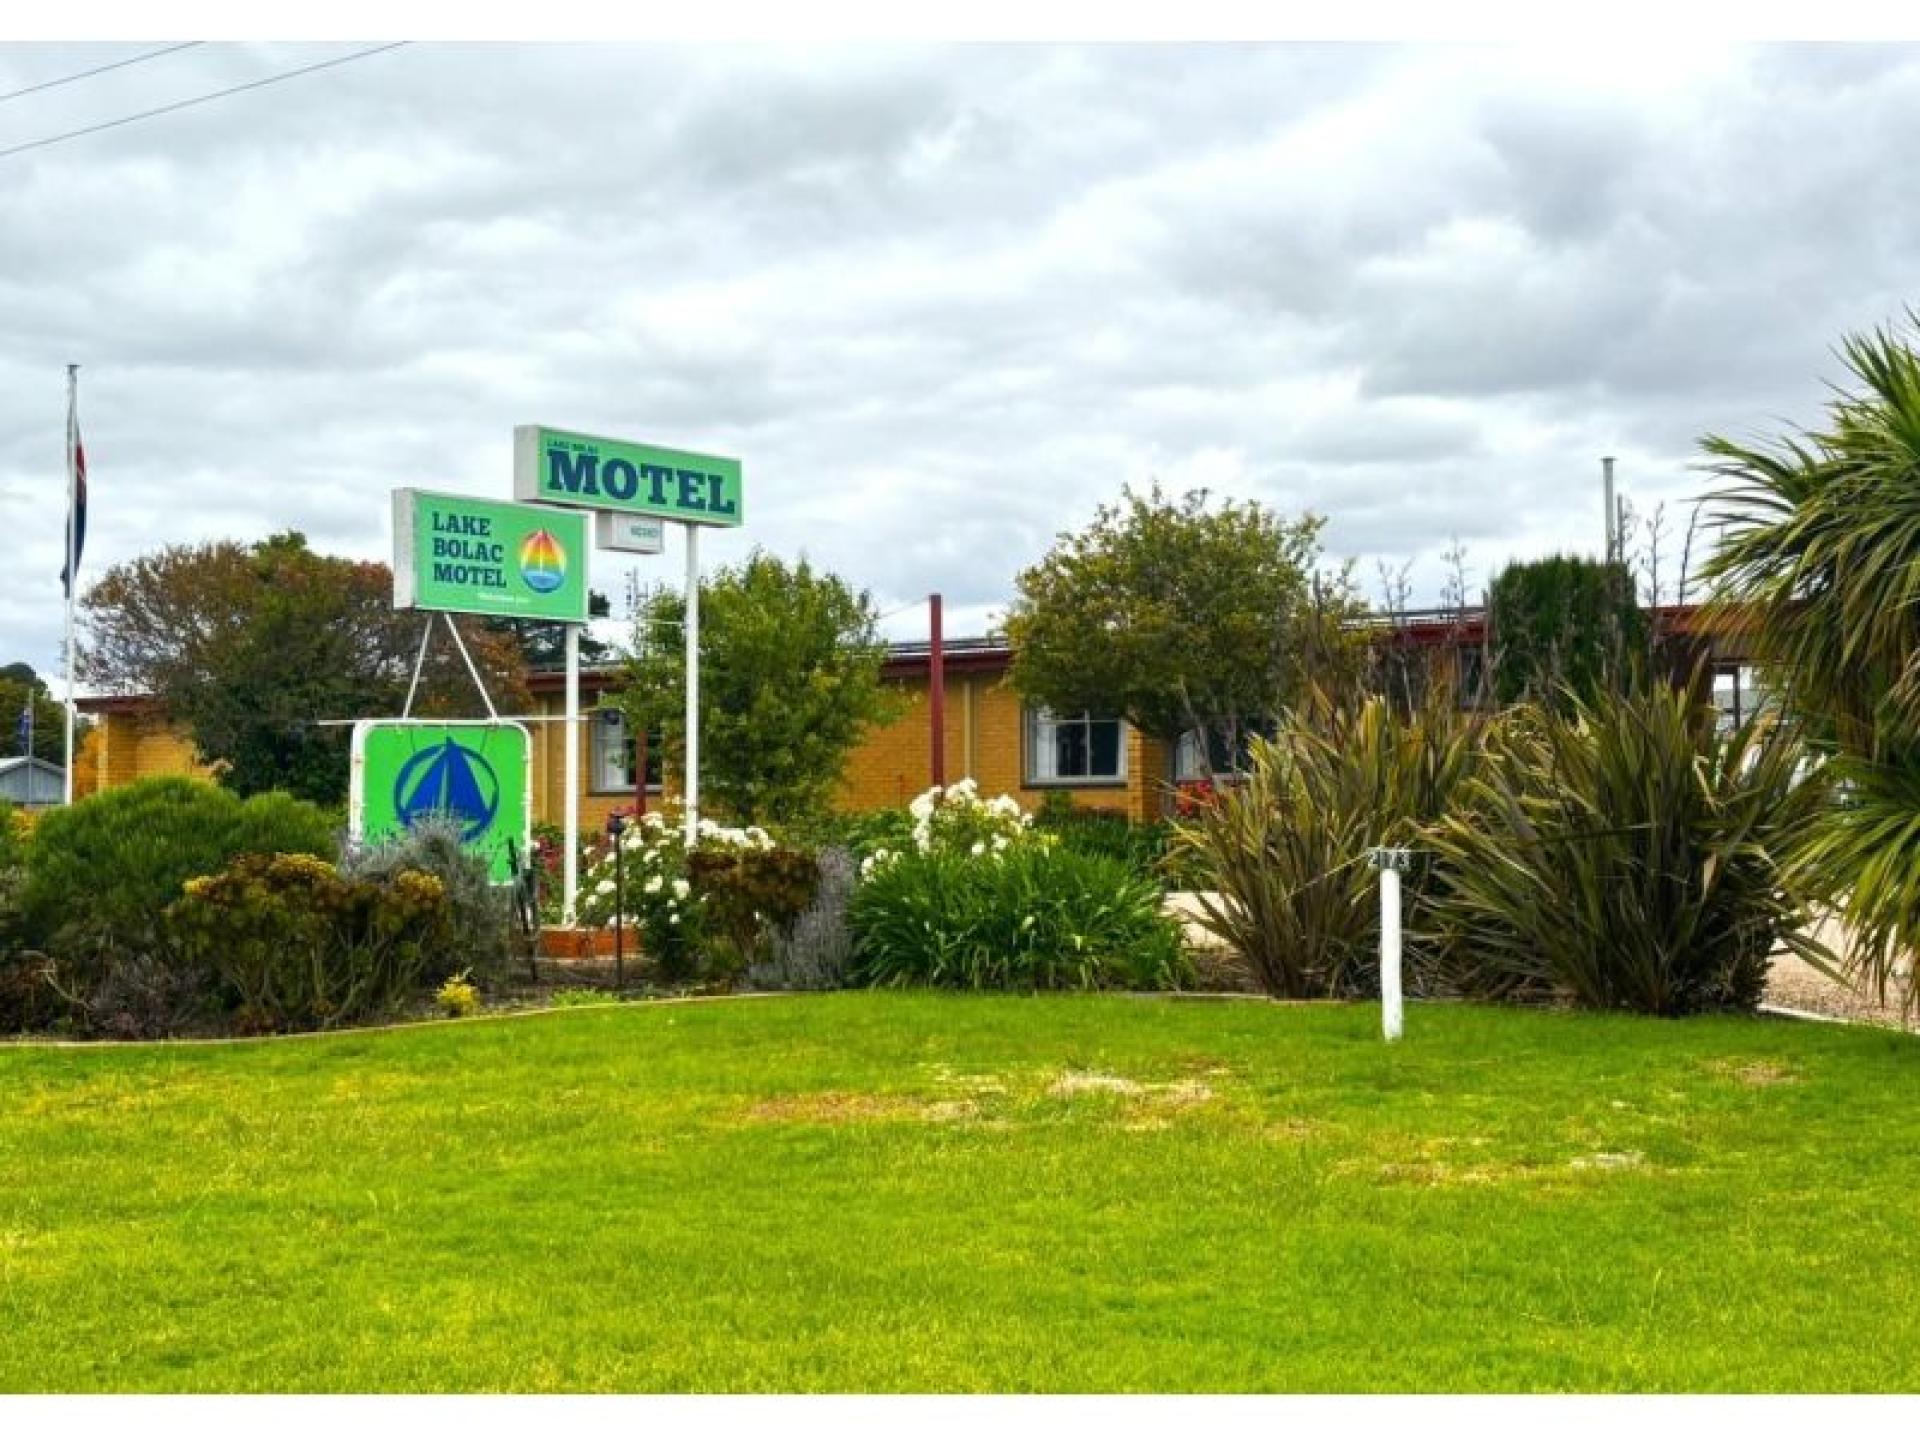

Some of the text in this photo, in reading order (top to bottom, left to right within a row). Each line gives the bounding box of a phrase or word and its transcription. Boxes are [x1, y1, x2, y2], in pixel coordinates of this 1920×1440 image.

[547, 449, 735, 514] MOTEL
[432, 511, 491, 536] LAKE
[432, 537, 505, 563] BOLAC
[433, 563, 507, 588] MOTEL
